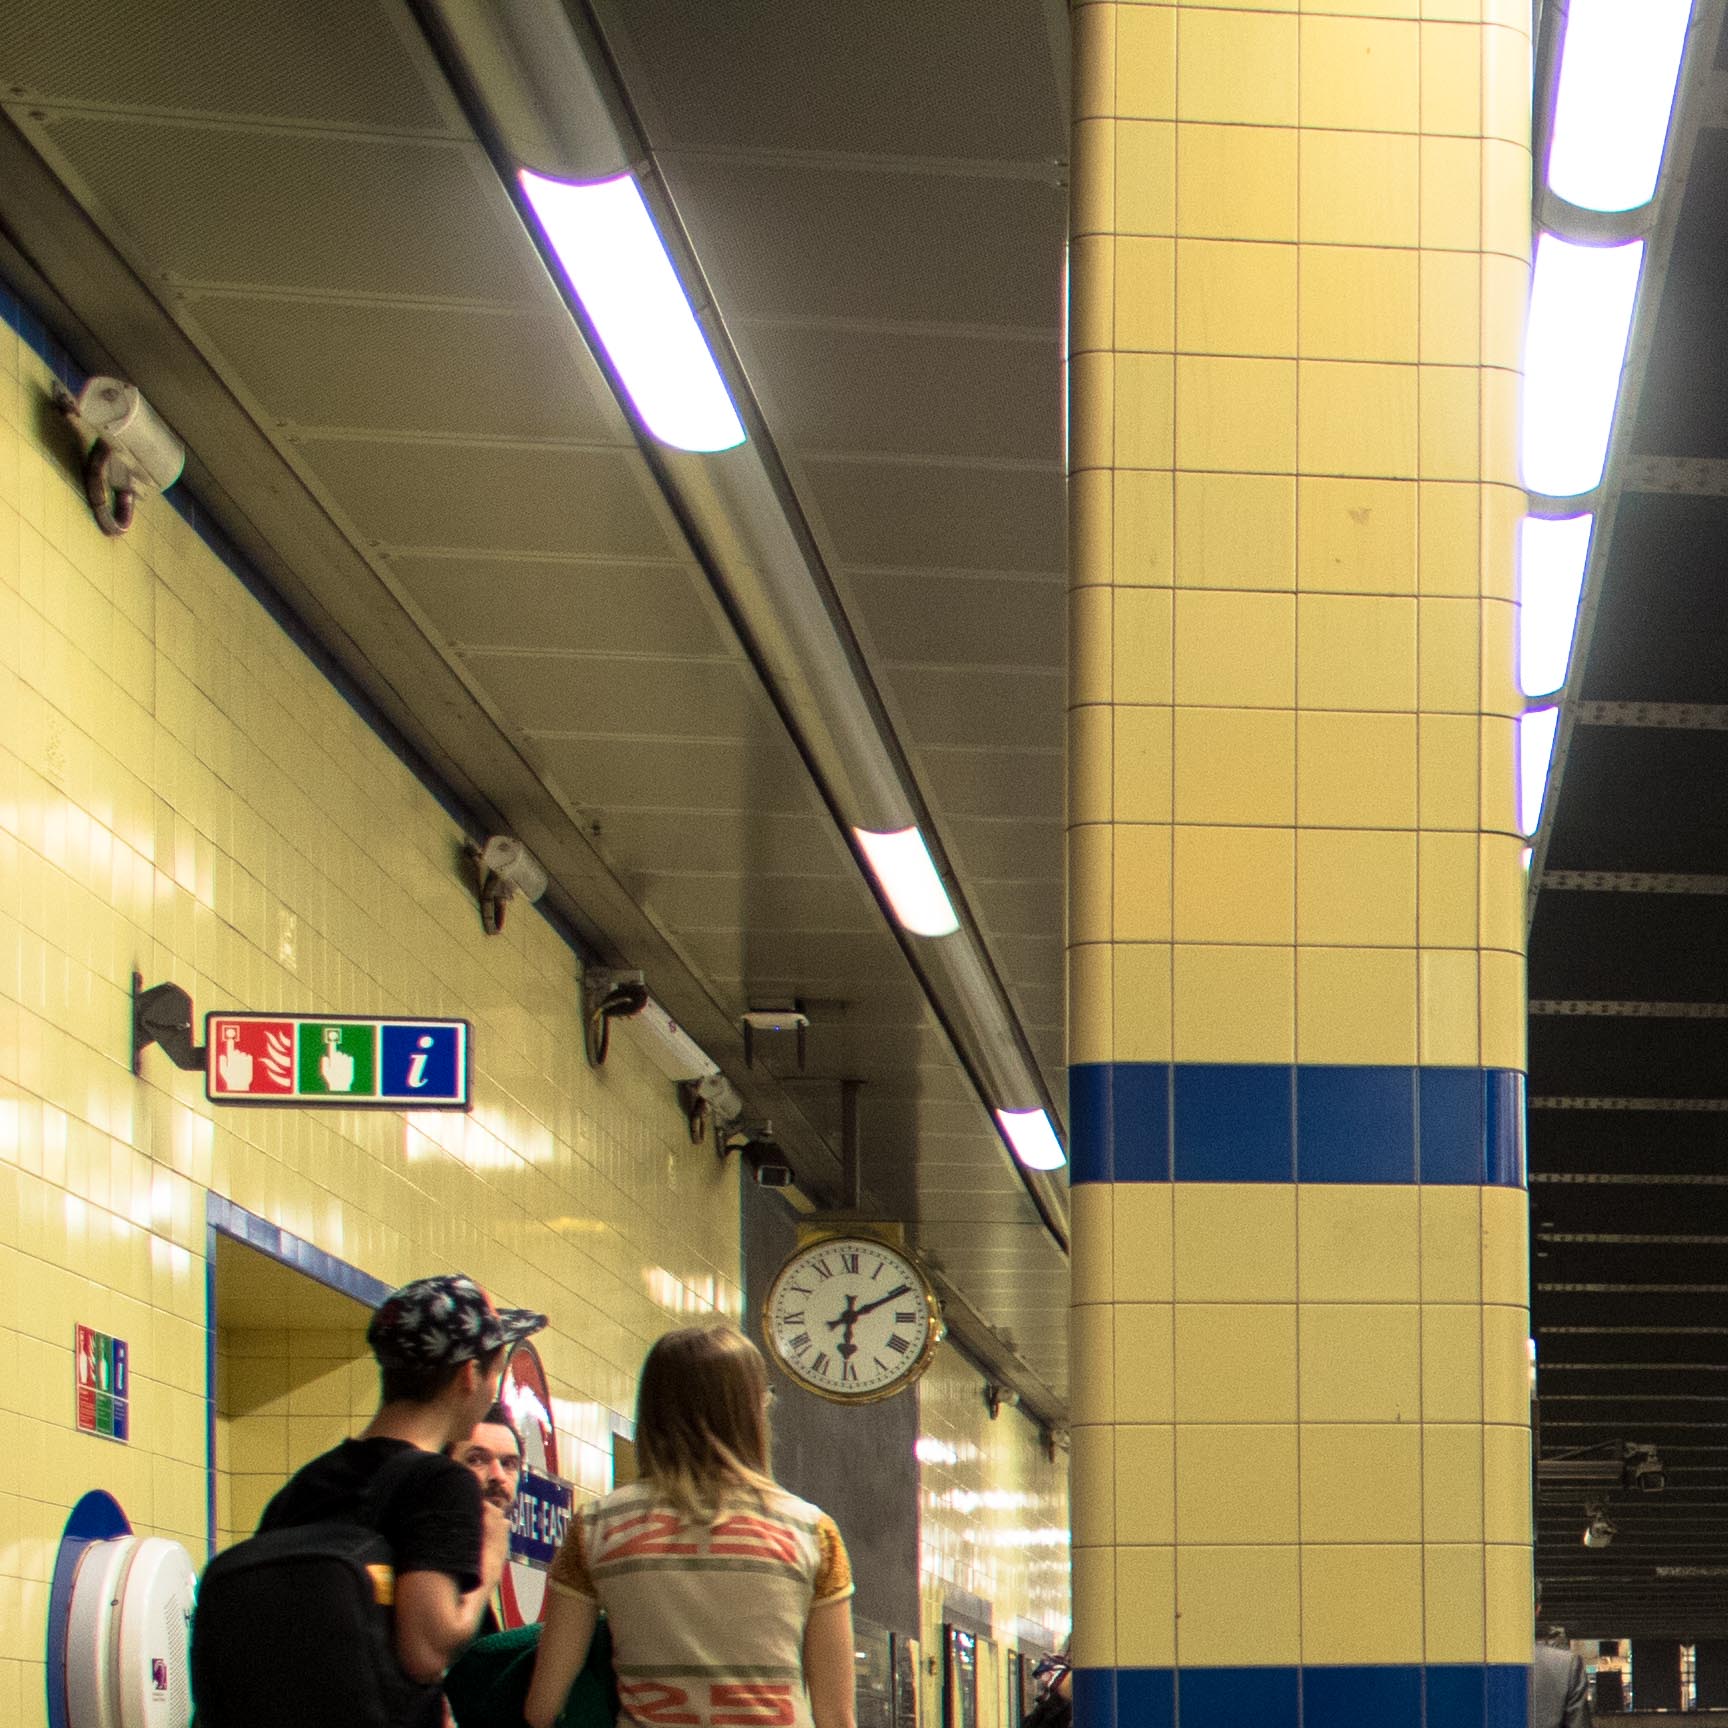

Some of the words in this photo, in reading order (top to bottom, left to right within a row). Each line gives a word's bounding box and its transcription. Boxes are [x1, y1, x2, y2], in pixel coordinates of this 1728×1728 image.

[840, 1253, 859, 1274] XII
[871, 1262, 884, 1280] I
[895, 1311, 917, 1324] III
[542, 1500, 572, 1547] EAST
[616, 1682, 796, 1727] 25
